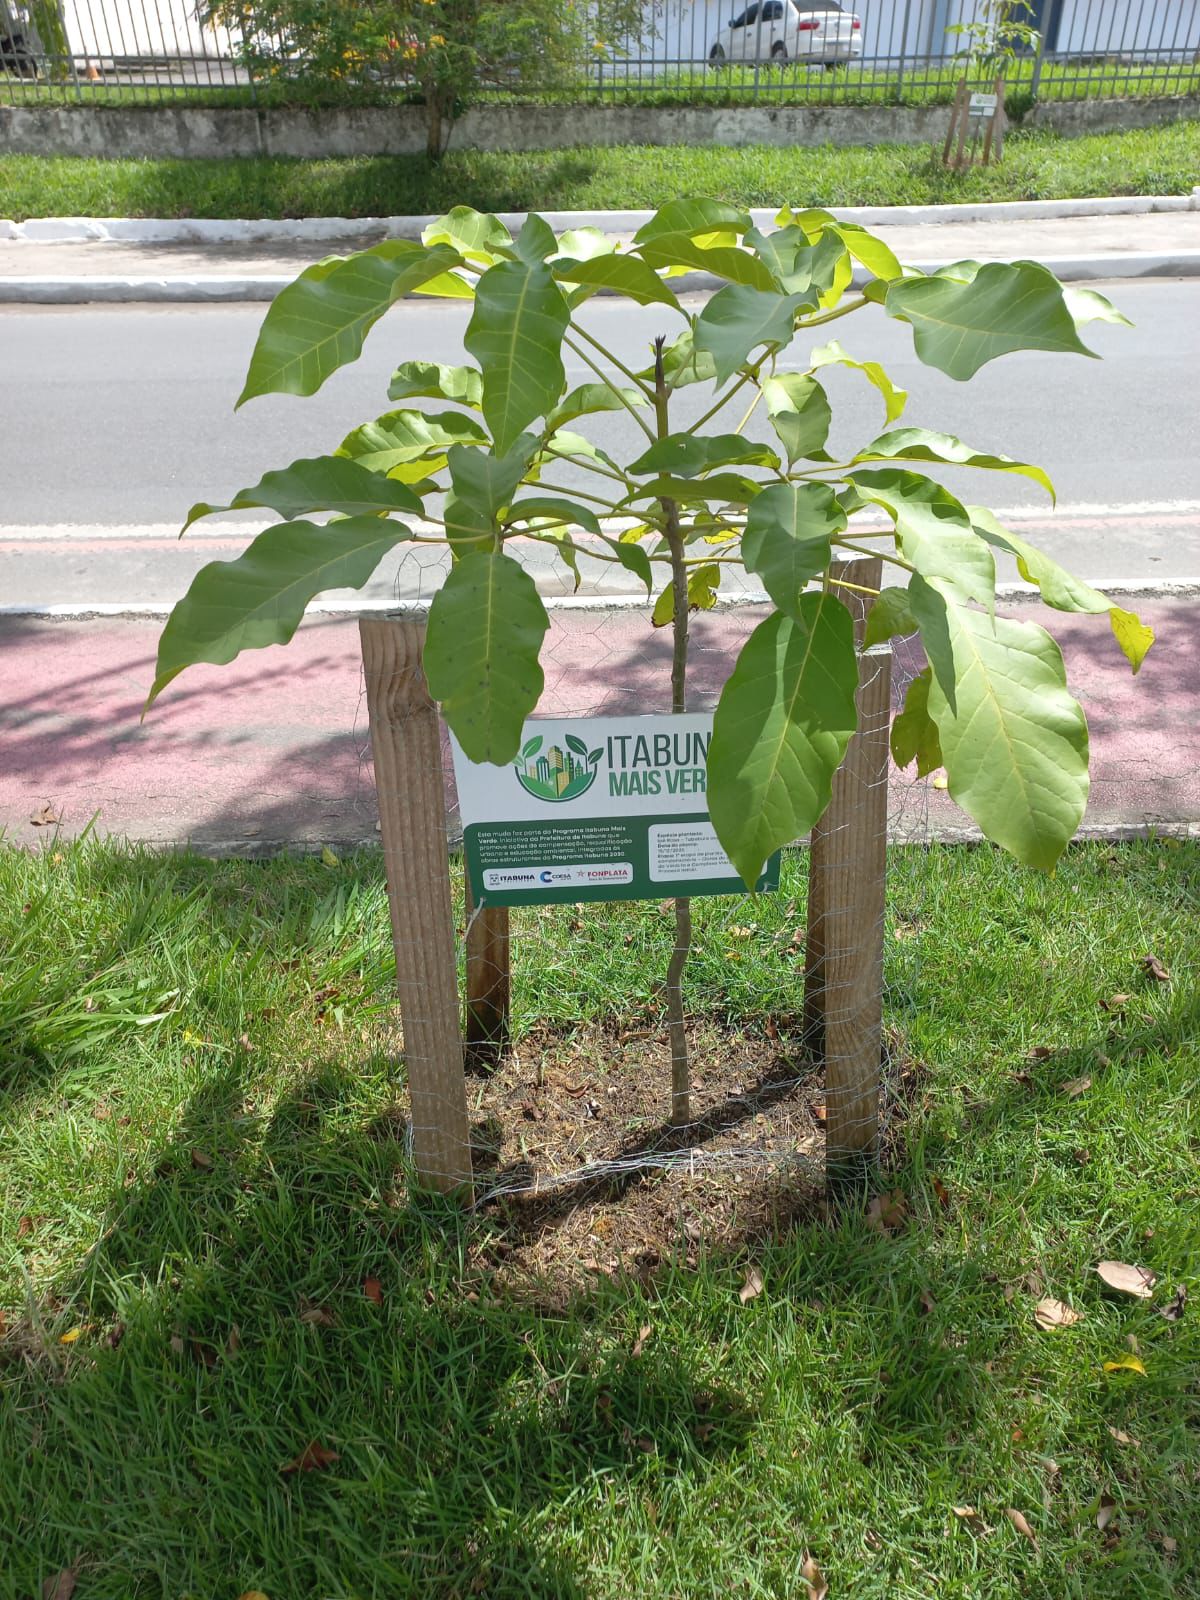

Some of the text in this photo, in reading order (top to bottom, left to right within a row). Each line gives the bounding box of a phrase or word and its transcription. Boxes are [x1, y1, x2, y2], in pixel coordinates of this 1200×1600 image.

[607, 731, 712, 769] ITABUN
[608, 768, 707, 797] MAIS VER
[584, 851, 609, 859] Itabuna
